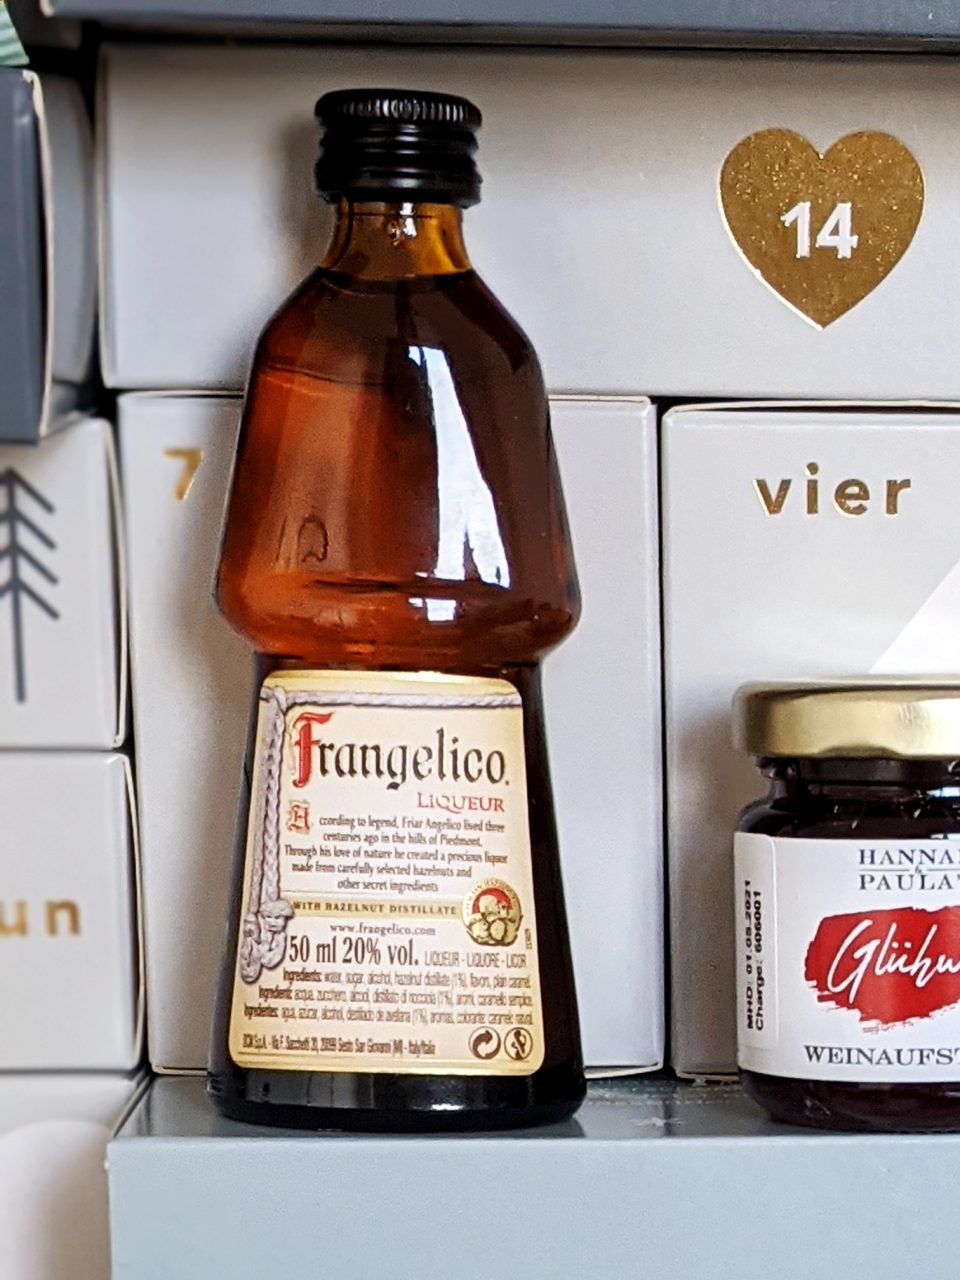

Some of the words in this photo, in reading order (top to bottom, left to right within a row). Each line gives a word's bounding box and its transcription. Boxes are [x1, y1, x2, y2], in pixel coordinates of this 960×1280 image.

[780, 201, 858, 259] 14
[164, 448, 204, 501] 7
[754, 463, 912, 518] vier
[293, 901, 321, 911] WITH
[325, 902, 385, 913] HAZELNUT
[389, 905, 457, 915] DISTILLATE
[330, 922, 436, 936] www.frangelico.com
[289, 935, 310, 963] 50
[316, 936, 337, 963] ml
[342, 937, 381, 965] 20%
[387, 939, 419, 966] vol.
[755, 959, 765, 1031] Charge:
